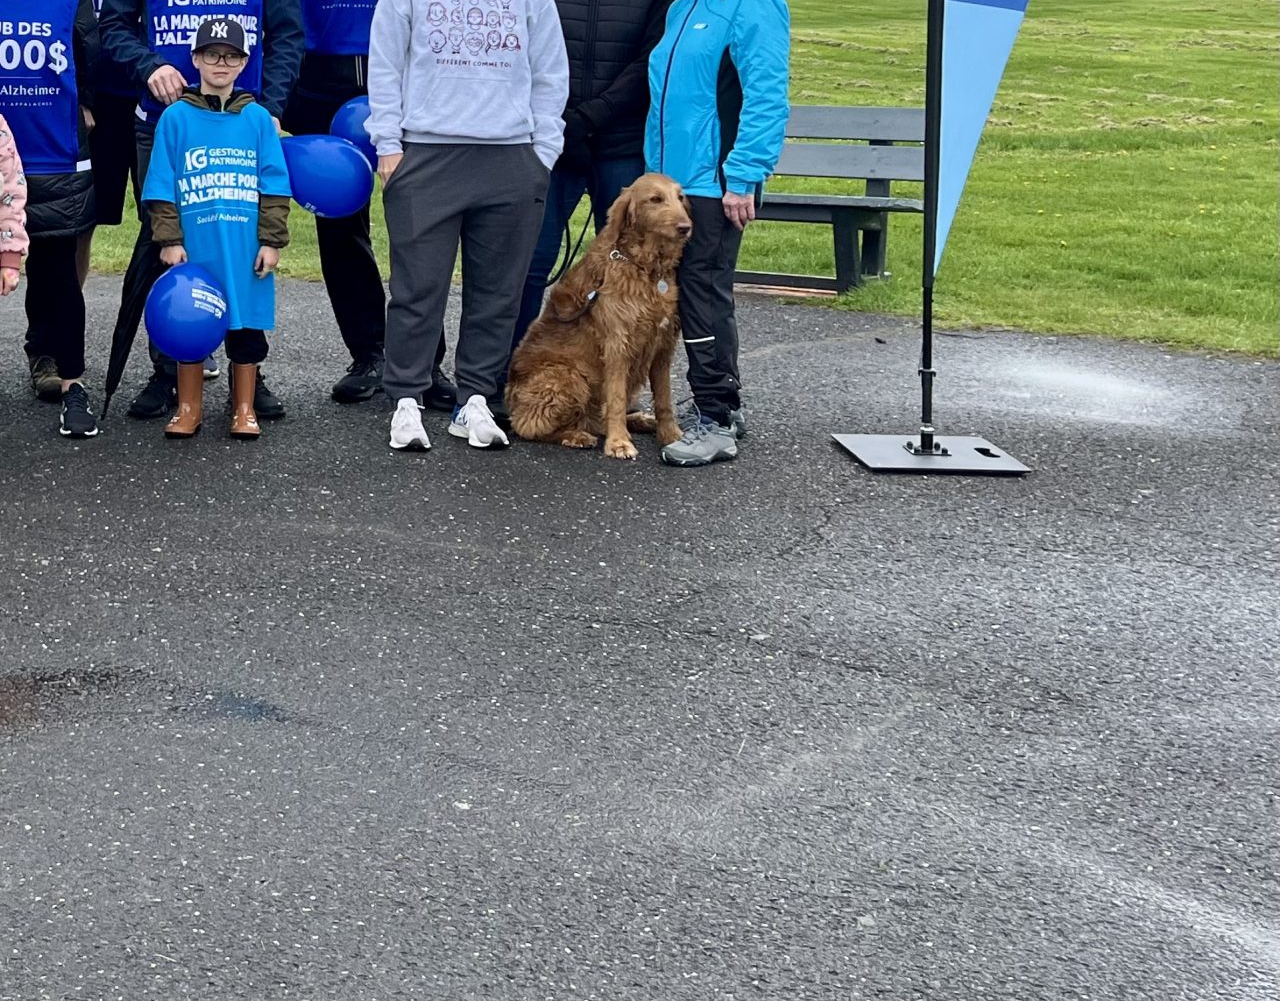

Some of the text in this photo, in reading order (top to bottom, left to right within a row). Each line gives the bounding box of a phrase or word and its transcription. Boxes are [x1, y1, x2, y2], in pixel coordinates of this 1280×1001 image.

[18, 21, 52, 37] DES
[153, 15, 169, 31] LA
[0, 84, 60, 96] Alzheimer
[184, 149, 207, 171] IG
[209, 148, 245, 157] GESTION
[209, 157, 257, 167] PATRIMOINE
[190, 172, 237, 190] MARCHE
[238, 173, 258, 189] POU
